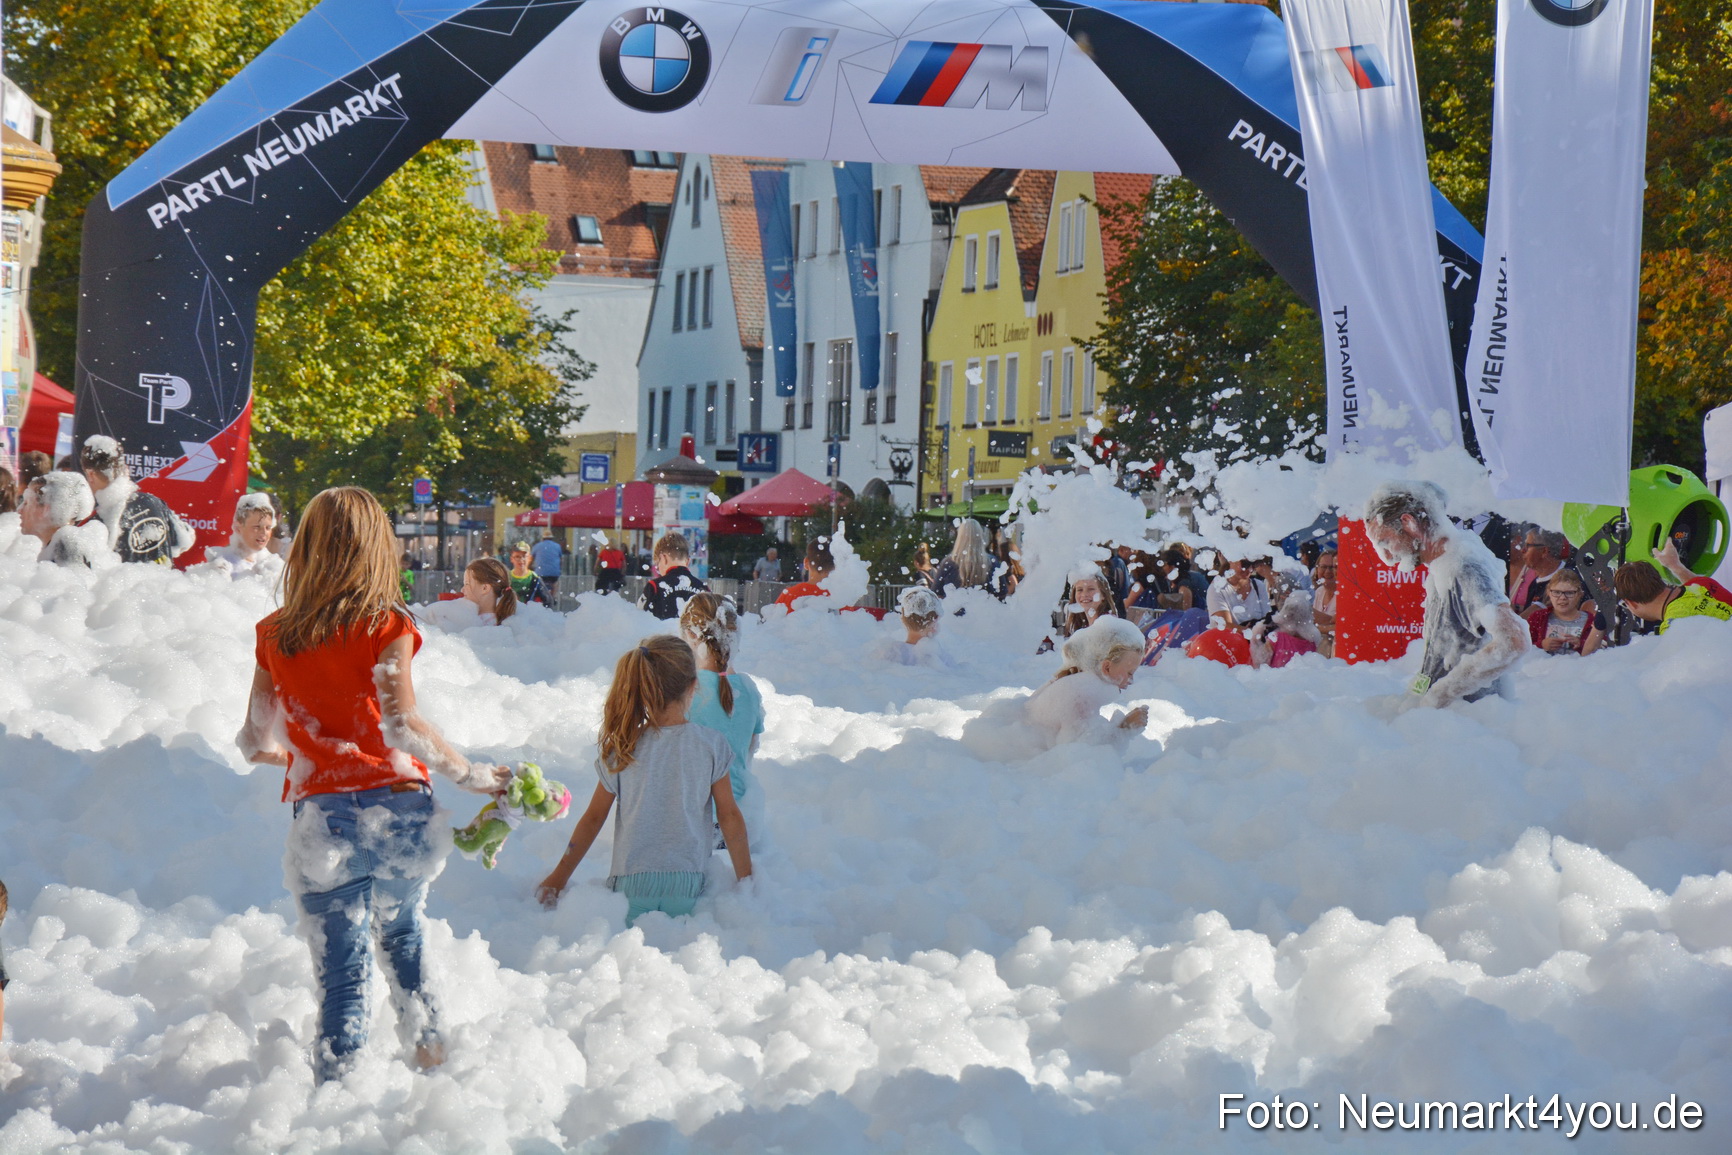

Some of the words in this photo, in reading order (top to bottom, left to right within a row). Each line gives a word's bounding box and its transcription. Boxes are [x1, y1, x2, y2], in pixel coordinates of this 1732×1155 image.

[611, 7, 701, 41] BMW
[147, 166, 246, 229] PARTL
[244, 73, 404, 177] NEUMARKT
[974, 322, 998, 349] HOTEL
[1003, 322, 1030, 343] Lehmeier
[990, 446, 1025, 455] TAIFUN
[144, 455, 175, 467] NEXT
[129, 466, 160, 478] EARS
[1377, 570, 1418, 584] BMW
